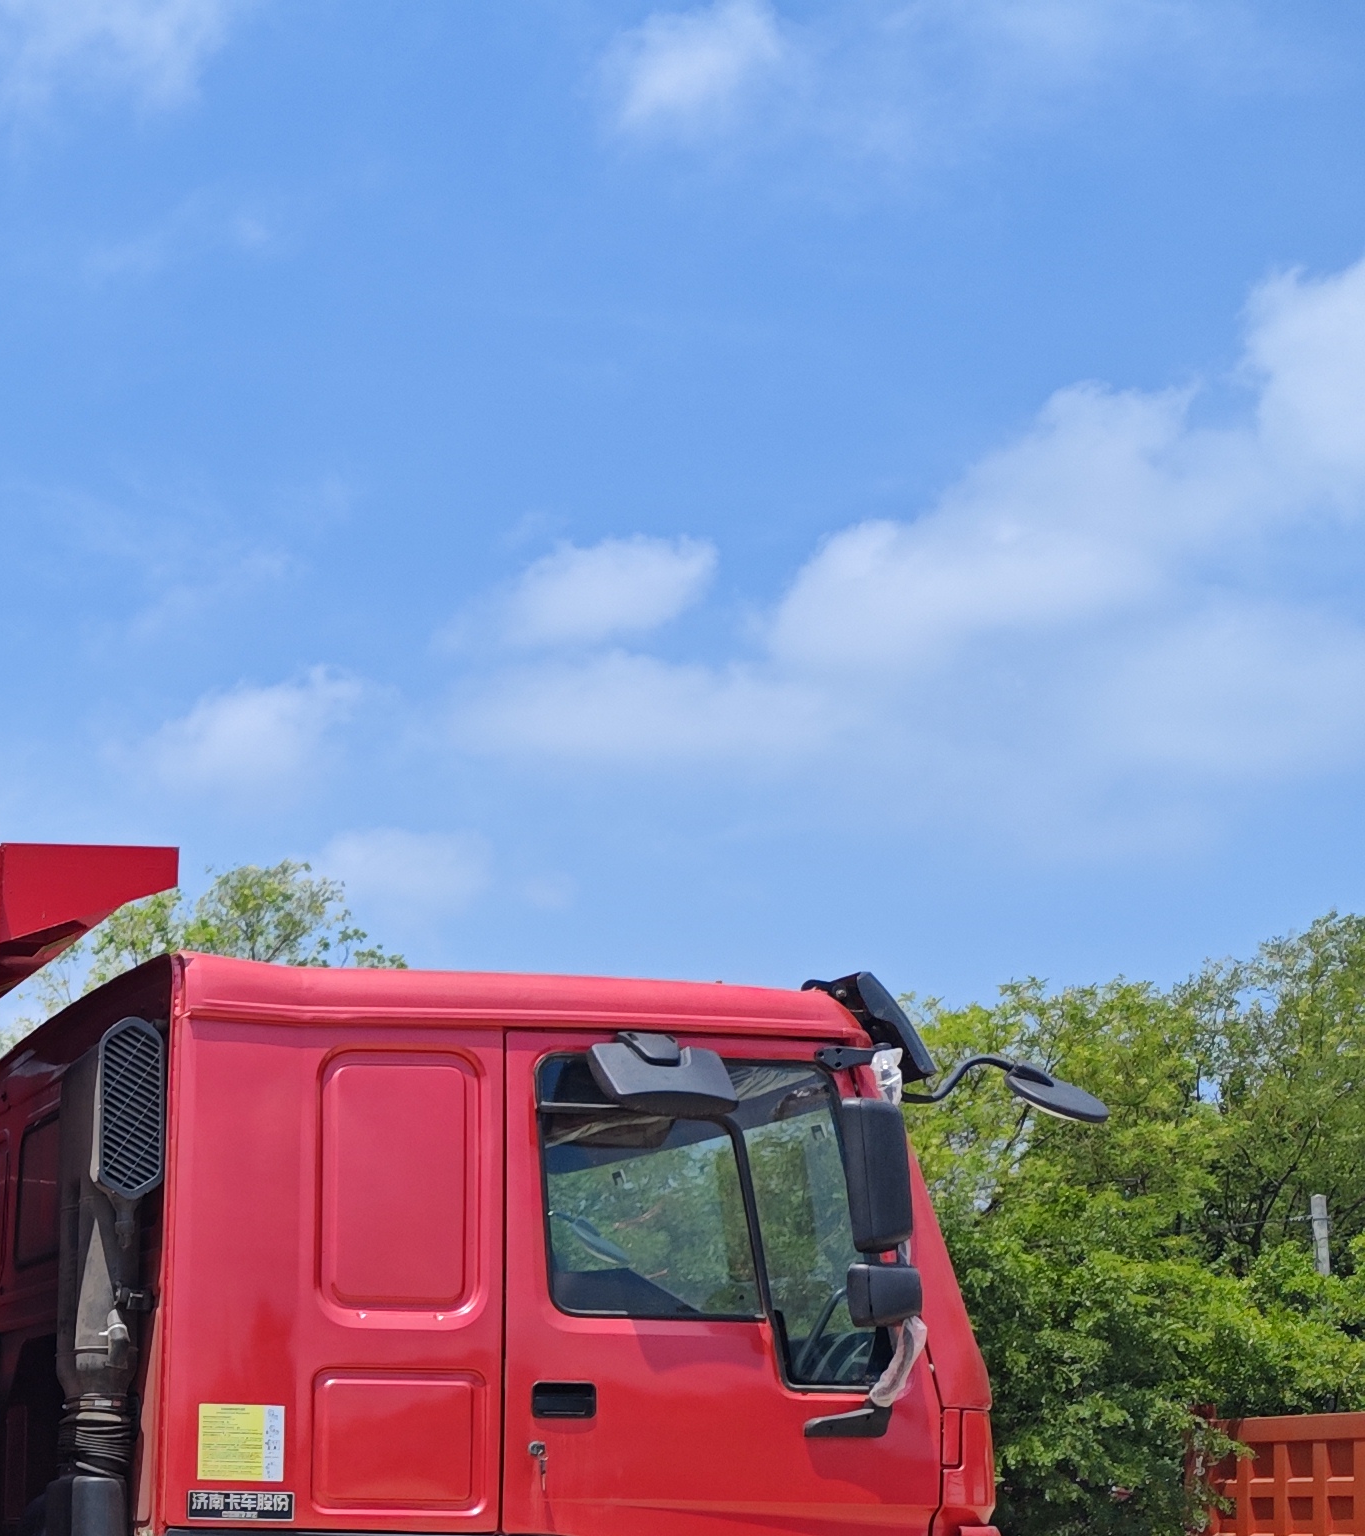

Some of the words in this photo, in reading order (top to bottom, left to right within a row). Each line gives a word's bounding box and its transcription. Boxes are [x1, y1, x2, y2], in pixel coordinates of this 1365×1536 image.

[191, 1493, 290, 1512] 济南卡车股份
